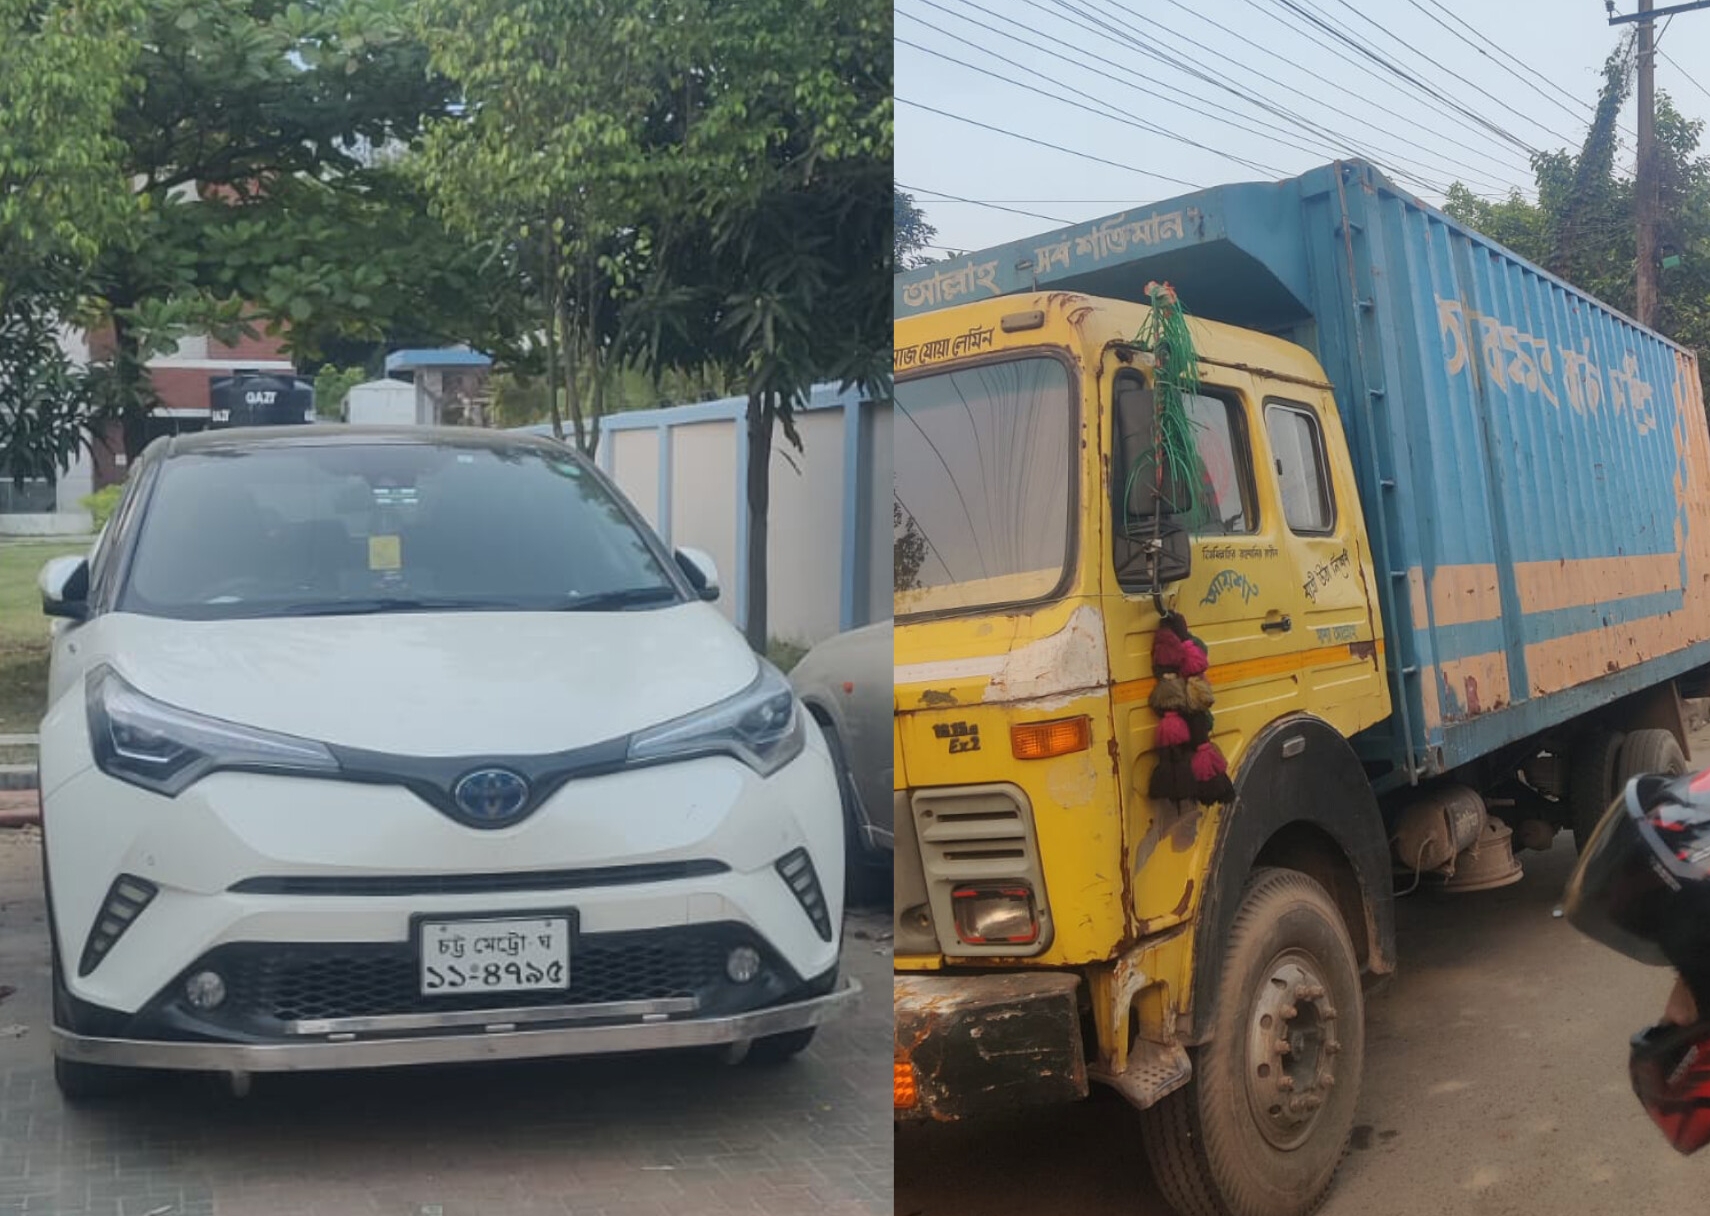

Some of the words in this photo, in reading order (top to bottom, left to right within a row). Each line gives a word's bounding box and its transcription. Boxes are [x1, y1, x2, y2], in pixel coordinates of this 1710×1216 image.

[903, 259, 1001, 308] আল্লাহ
[952, 325, 995, 357] লেমিন
[438, 935, 466, 958] চট্ট
[474, 931, 527, 956] মেট্রো
[426, 960, 563, 989] ১১-৪৭৯৫
